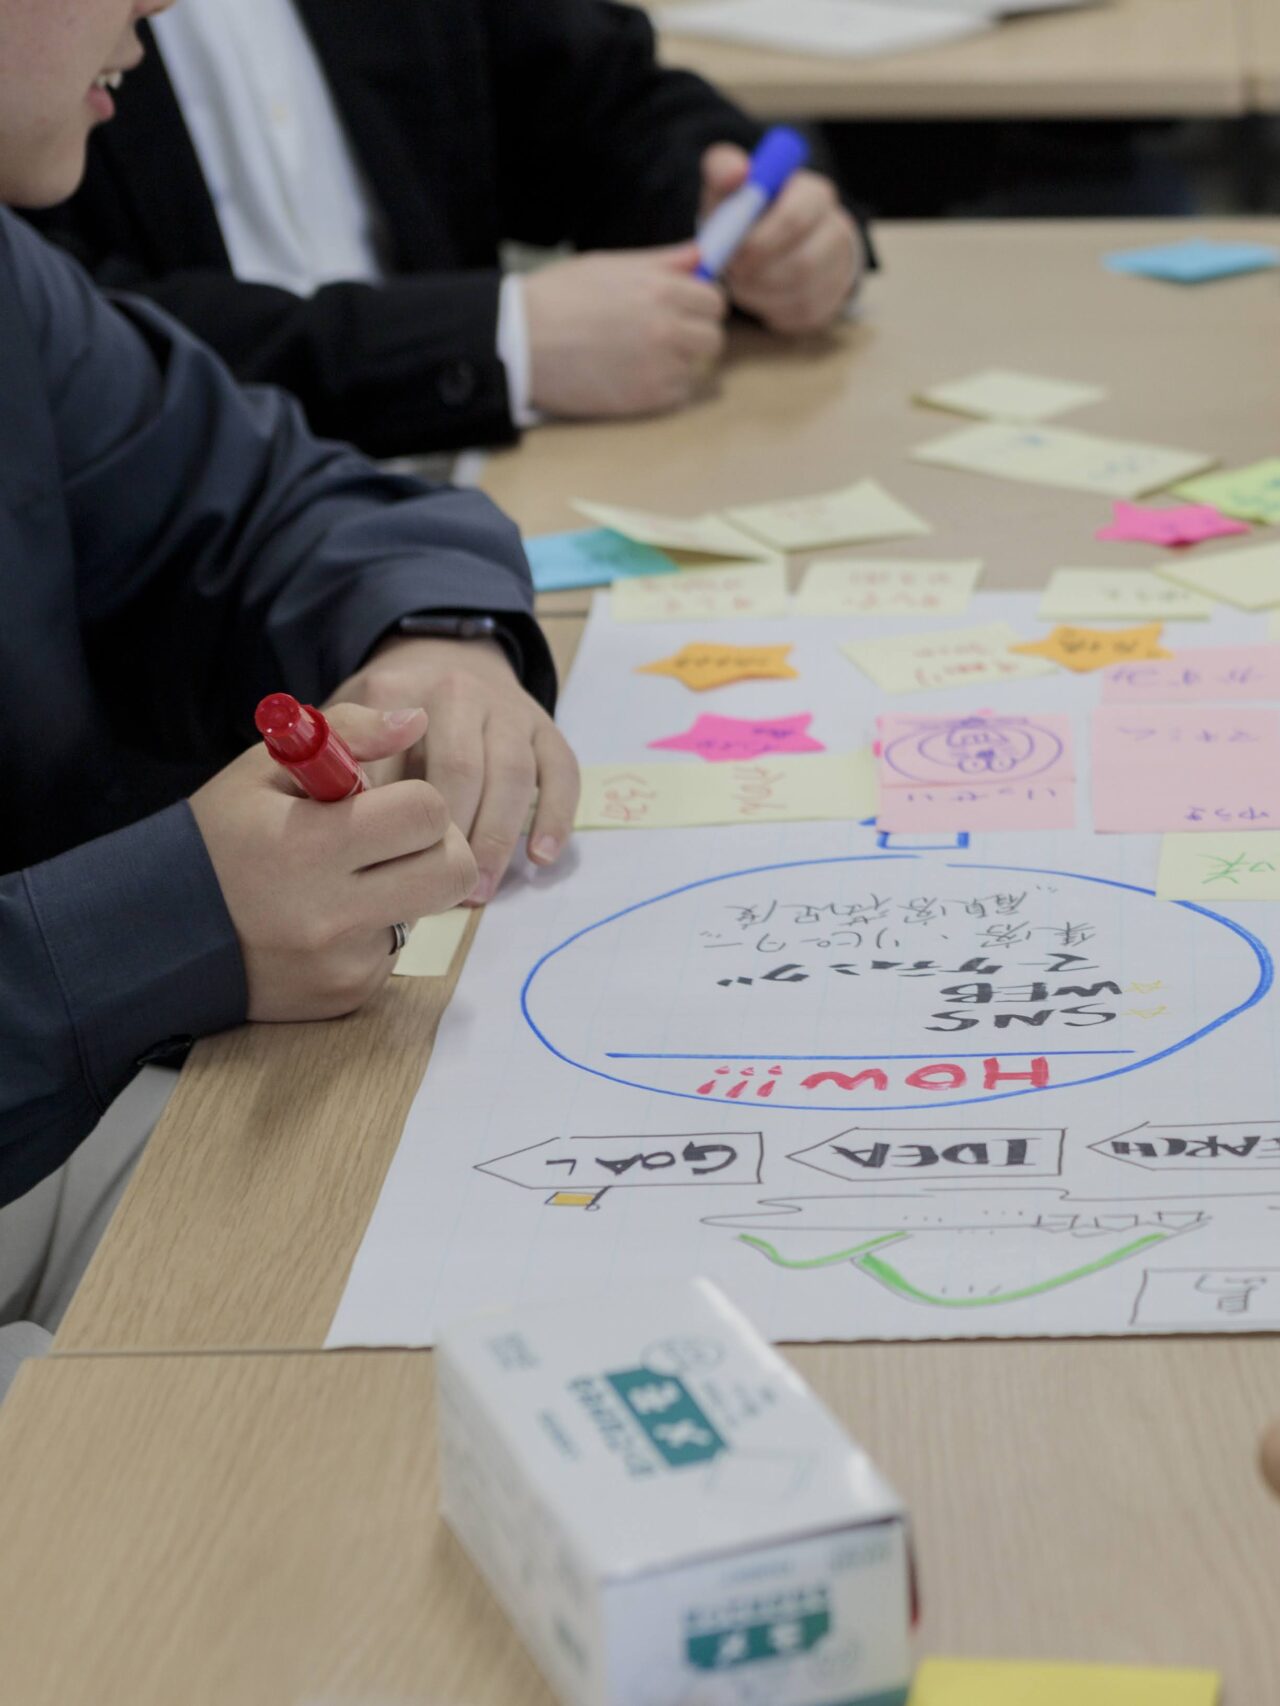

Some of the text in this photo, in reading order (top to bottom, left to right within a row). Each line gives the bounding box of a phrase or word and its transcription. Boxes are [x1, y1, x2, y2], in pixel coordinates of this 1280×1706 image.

[716, 953, 1100, 987] マーケティング
[938, 980, 1123, 1004] WEB
[922, 1002, 1117, 1032] SNS
[695, 1056, 1050, 1099] HOW!!!
[544, 1141, 739, 1176] GOAL
[829, 1138, 1039, 1169] IDEA
